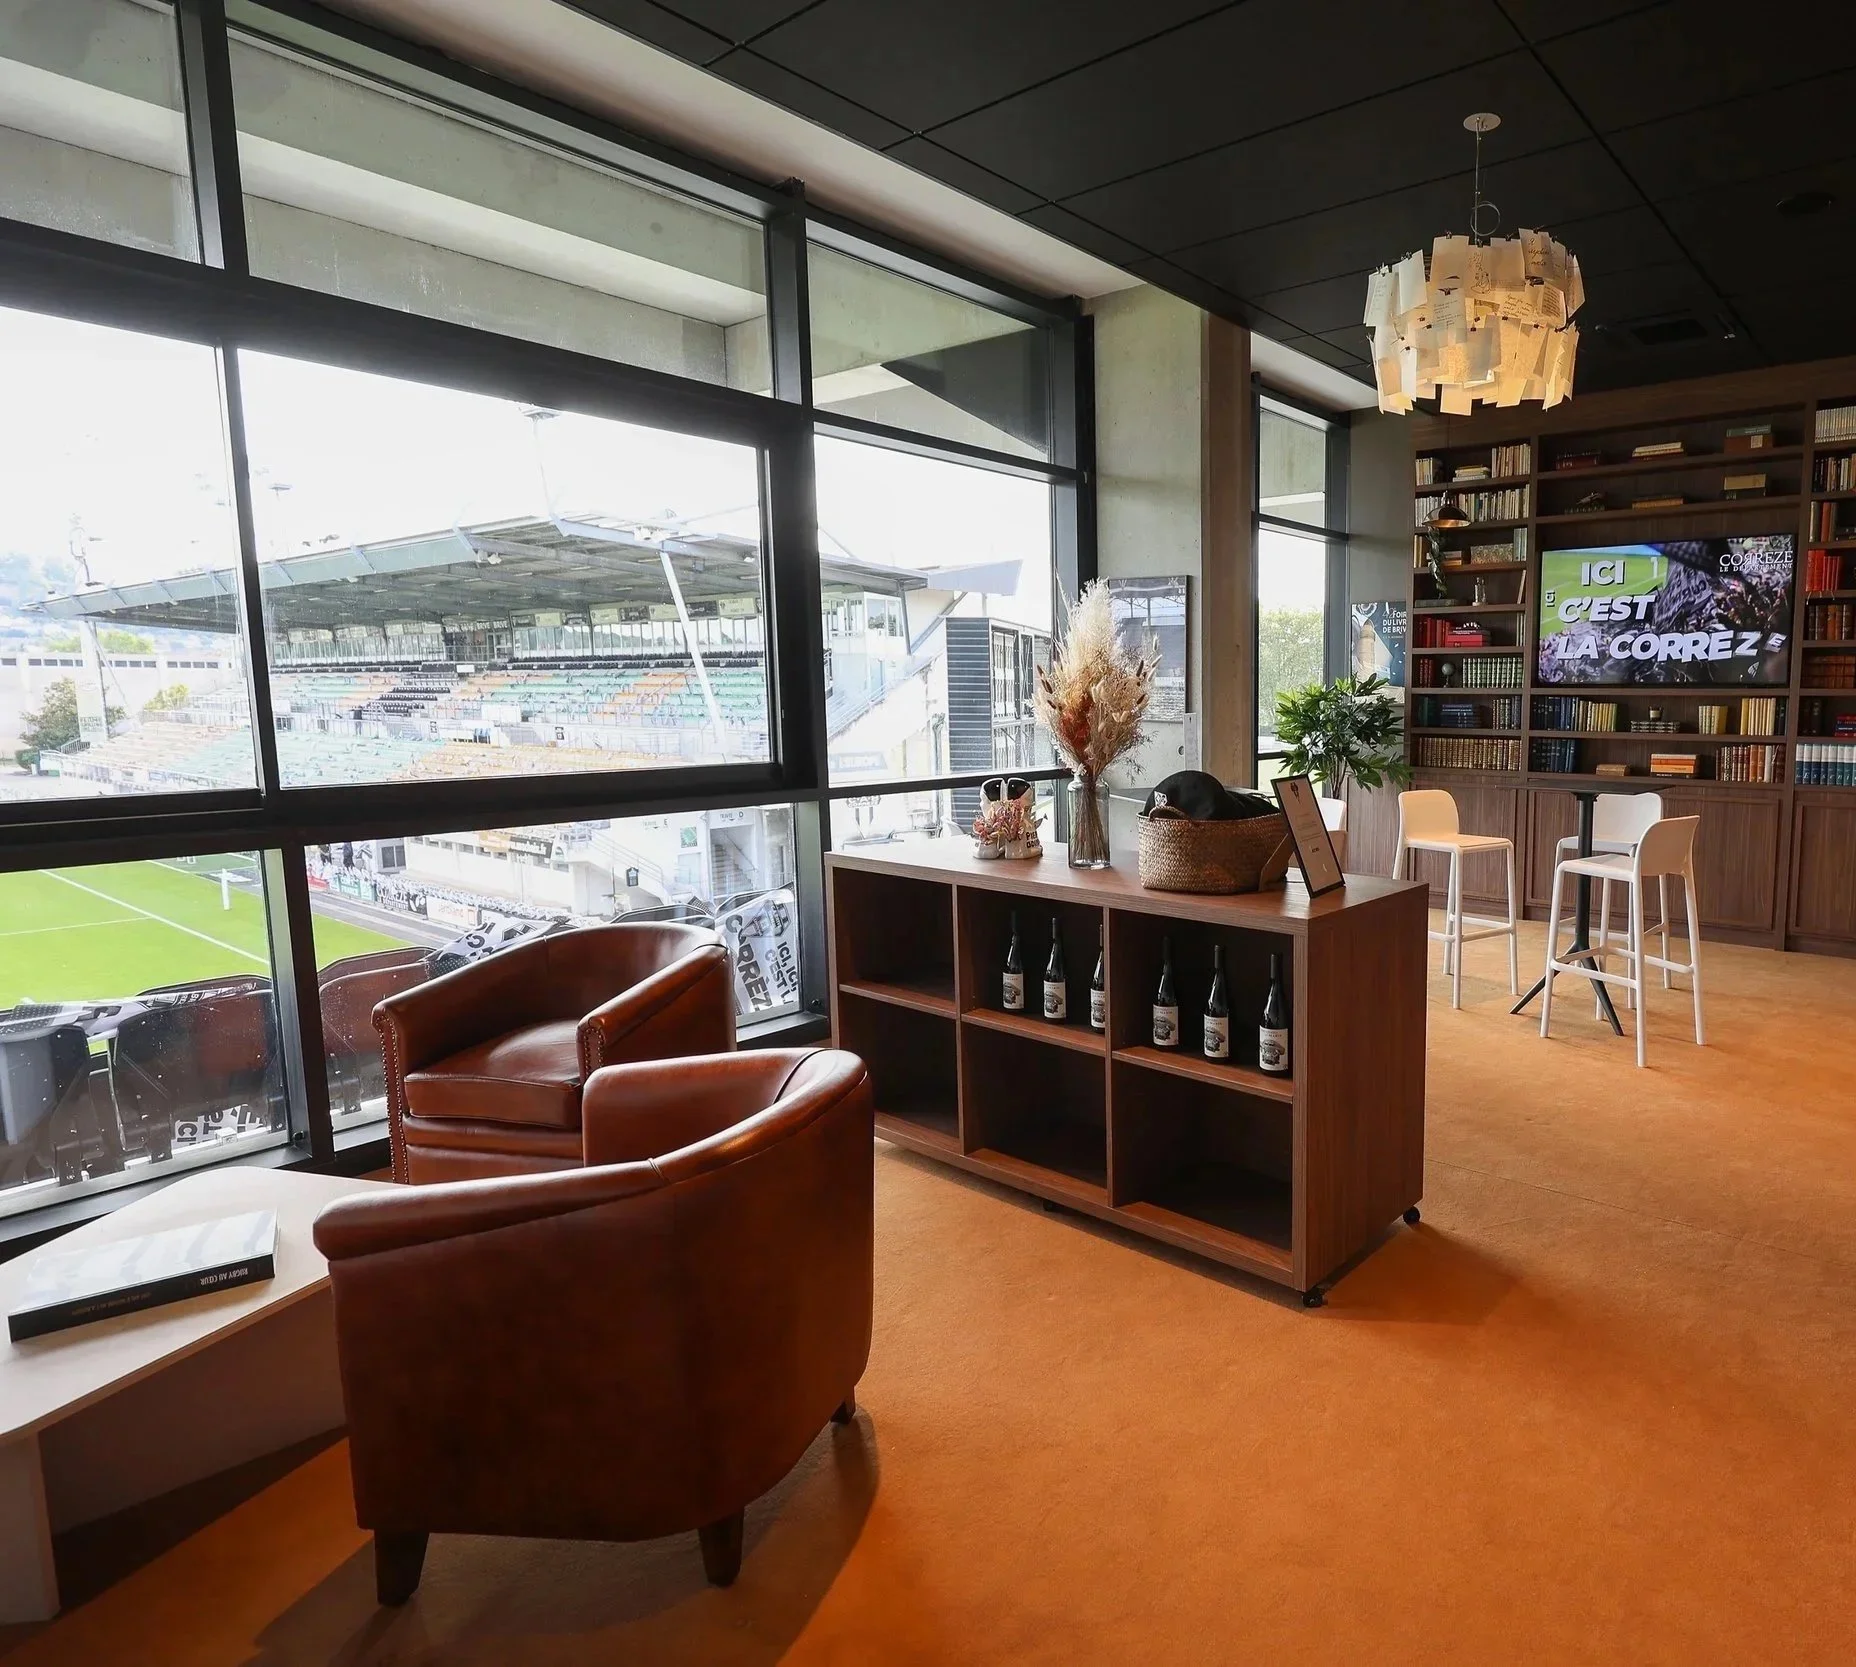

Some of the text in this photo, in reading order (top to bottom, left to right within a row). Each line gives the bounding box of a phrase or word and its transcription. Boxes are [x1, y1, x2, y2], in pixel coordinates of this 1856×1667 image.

[1581, 560, 1625, 586] ICI
[1393, 610, 1406, 618] FOIR
[1557, 594, 1656, 623] C'EST
[1393, 626, 1406, 634] BRIV
[1556, 636, 1599, 660] LA
[777, 941, 792, 969] ICI,
[764, 948, 788, 990] C'EST
[218, 1272, 228, 1282] AU
[228, 1267, 249, 1281] RUGBY
